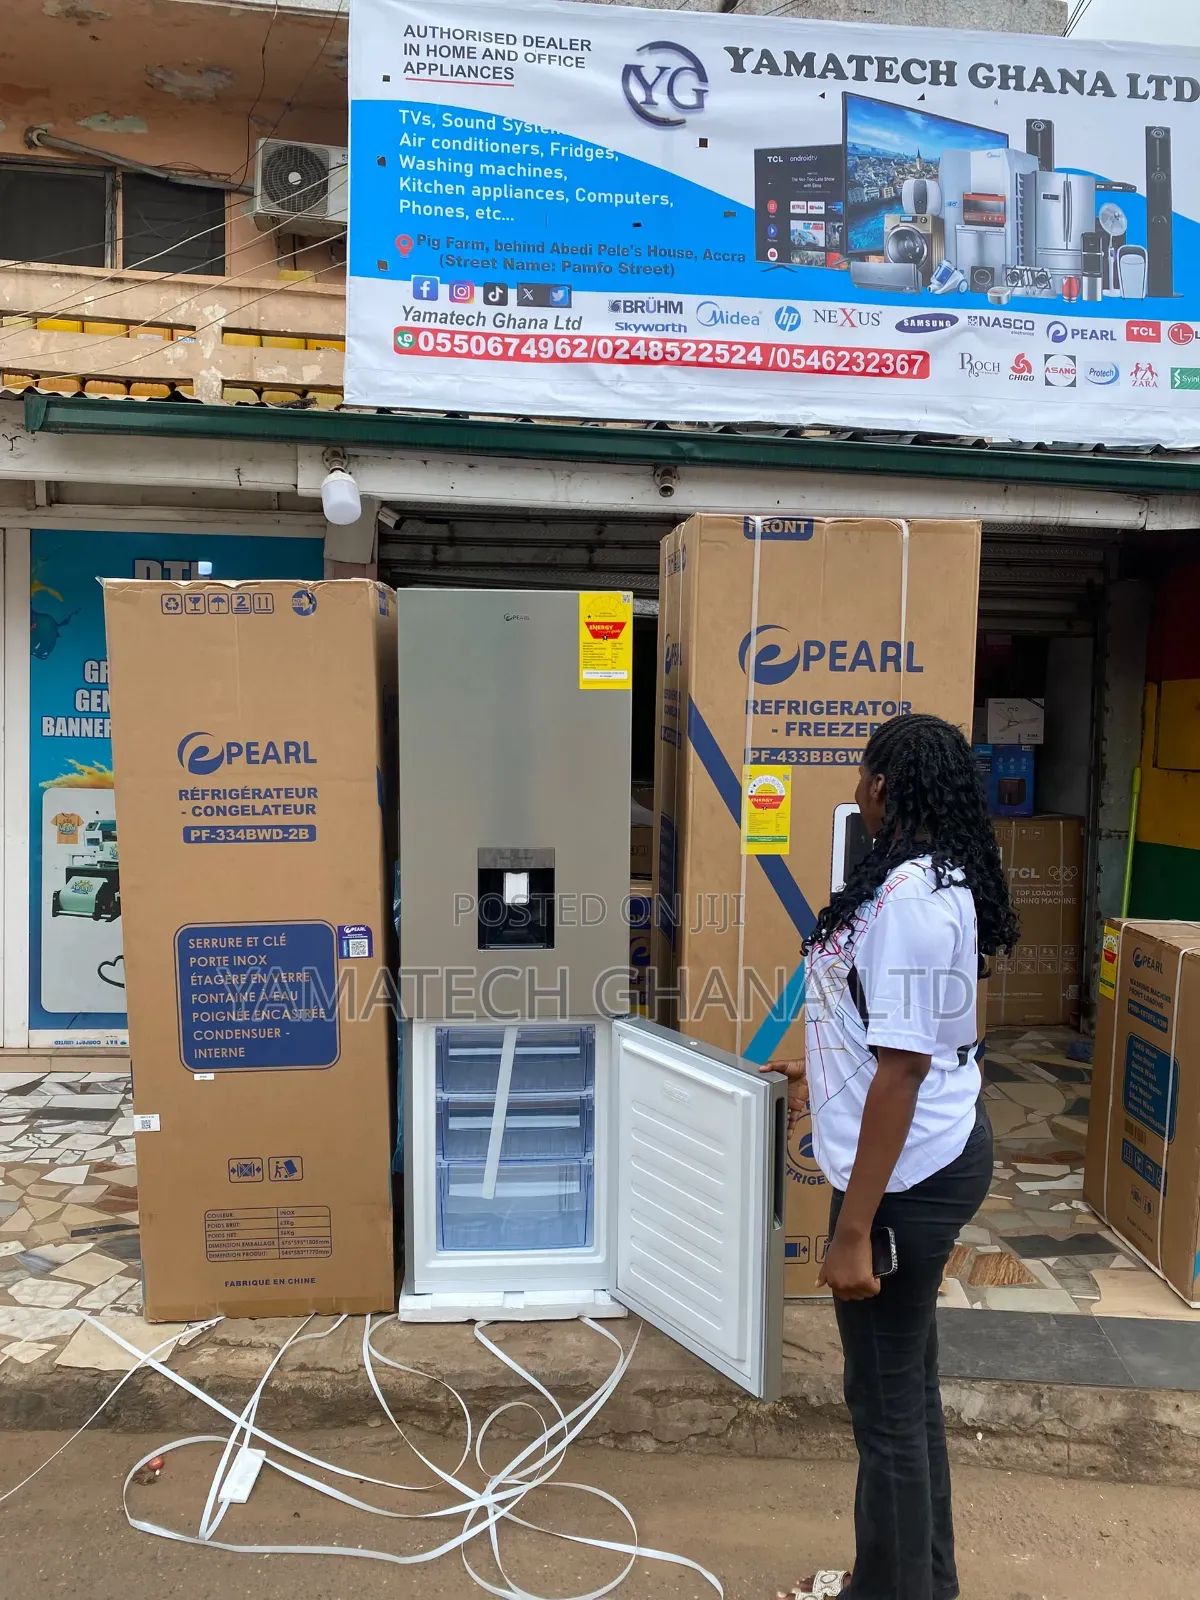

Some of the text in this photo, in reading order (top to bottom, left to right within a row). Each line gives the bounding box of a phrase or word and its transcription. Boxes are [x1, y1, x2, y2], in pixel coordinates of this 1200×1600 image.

[403, 24, 592, 53] AUTHORISED DEALER
[403, 43, 587, 69] IN HOME AND OFFICE
[403, 61, 515, 80] APPLIANCES
[723, 45, 1200, 103] YAMATECH GHANA LTD
[399, 109, 437, 129] TVs,
[442, 113, 496, 132] Sound
[399, 132, 620, 163] Air conditioners, Fridges,
[399, 154, 568, 182] Washing machines,
[399, 178, 674, 209] Kitchen appliances, Computers,
[399, 201, 515, 222] Phones, etc...
[417, 234, 746, 264] Pig Farm, behind Abedi Pele's House, Accra
[438, 254, 676, 278] (Street Name: Pamfo Street)
[622, 296, 684, 316] BRÜHM
[402, 305, 583, 332] Yamatech Ghana Ltd
[776, 305, 802, 332] hp
[812, 307, 880, 329] NEXUS
[902, 318, 952, 329] SAMSUNG
[978, 315, 1036, 331] NASCO
[614, 320, 688, 335] Skyworth
[1070, 328, 1118, 342] PEARL
[1130, 326, 1157, 337] TCL
[1008, 373, 1035, 382] CHIGO
[1044, 366, 1077, 376] ASANO
[1088, 367, 1115, 378] Protech
[1183, 374, 1200, 383] Syini
[1131, 379, 1159, 389] ZARA
[588, 624, 614, 632] ENERGY
[802, 638, 925, 674] PEARL
[745, 699, 912, 717] REFRIGERATOR
[226, 740, 318, 766] PEARL
[178, 786, 319, 801] RÉFRIGÉRATEUR
[191, 804, 317, 817] CONGELATEUR
[190, 828, 310, 842] PF-334BWD-2B
[1007, 867, 1041, 879] TCL
[1015, 889, 1065, 897] TOP LOADING
[1013, 897, 1040, 905] SHING
[188, 933, 287, 949] SERRURE ET CLÉ
[189, 955, 268, 968] PORTE INOX
[1142, 954, 1164, 975] PEARL
[190, 971, 311, 986] ÉTAGÈRE EN VERRE
[191, 989, 298, 1004] FONTAINE À EAU
[192, 1007, 326, 1023] POIGNÉE ENCASTRÉE
[193, 1028, 281, 1041] CONDENSUER
[193, 1047, 246, 1059] INTERNE
[273, 1278, 286, 1286] EN
[287, 1277, 317, 1285] CHINE
